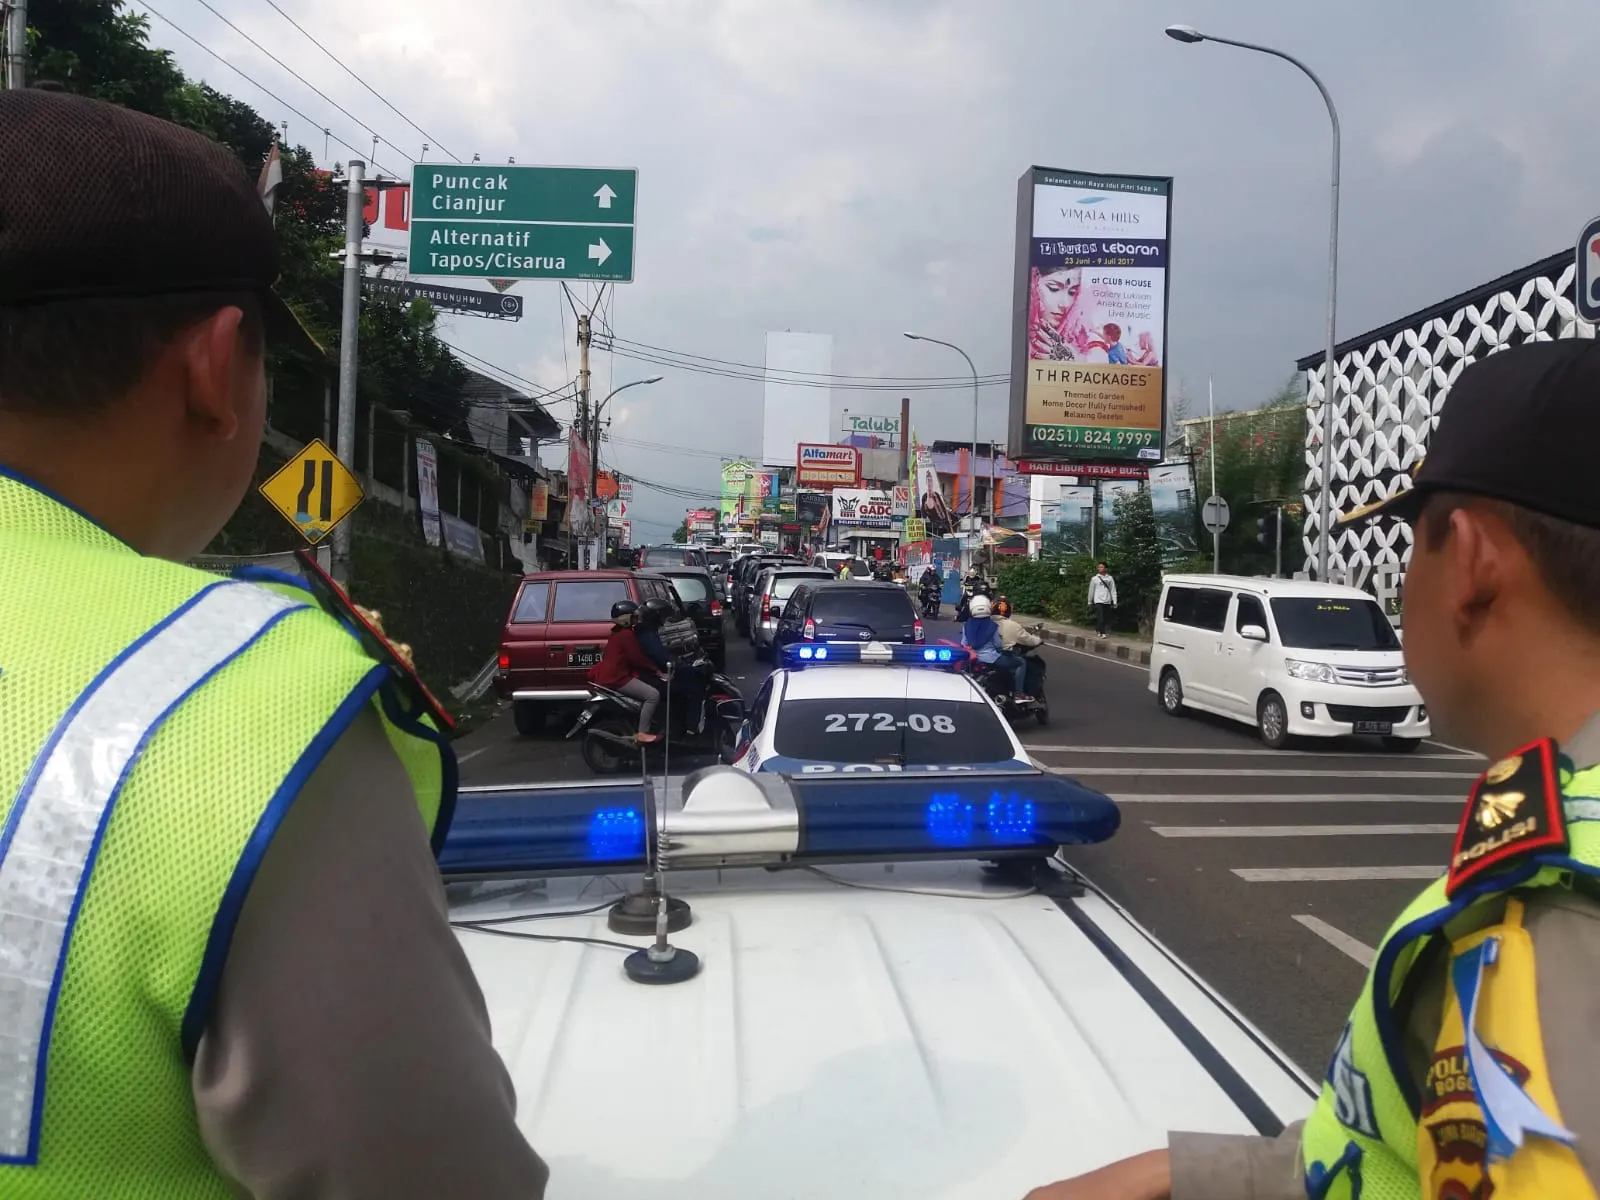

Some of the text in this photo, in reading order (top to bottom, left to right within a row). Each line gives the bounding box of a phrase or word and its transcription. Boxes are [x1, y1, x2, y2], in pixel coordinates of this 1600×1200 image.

[432, 173, 508, 190] Puncak
[1044, 176, 1071, 185] Selamat
[1073, 178, 1086, 186] Hari
[1088, 180, 1104, 189] Raya
[1106, 182, 1119, 190] Idul
[1120, 183, 1135, 191] Fitri
[432, 194, 505, 215] Cianjur
[1060, 207, 1140, 224] VIMALA HILLS
[429, 229, 531, 248] Alternatif
[1102, 242, 1159, 256] Lebaran
[429, 251, 566, 272] Tapos/Cisarua
[1064, 257, 1074, 265] 23
[1075, 257, 1090, 265] Juni
[1097, 257, 1102, 265] 9
[1103, 258, 1116, 266] Juli
[1117, 258, 1135, 266] 2017
[1091, 277, 1152, 288] at CLUB HOUSE
[415, 289, 482, 305] MEMBUNUHMU
[1092, 289, 1151, 301] Gallery Lukisan
[1096, 300, 1151, 310] Aneka Kuliner
[1108, 310, 1151, 320] Live Music
[1064, 390, 1125, 401] Thematic Garden
[1042, 399, 1064, 408] Home
[1065, 400, 1087, 409] Decor
[1088, 402, 1107, 412] (fully
[1064, 411, 1096, 420] Relaxing
[849, 416, 899, 432] Talubi
[1032, 427, 1152, 446] (0251) 824 9999
[803, 448, 853, 460] Alfamart
[1029, 463, 1053, 471] HARI
[1055, 464, 1085, 473] LIBUR
[1087, 465, 1117, 474] TETAP
[895, 501, 909, 510] BNI
[568, 654, 574, 663] B
[824, 712, 957, 734] 272-08
[1452, 815, 1538, 868] POLISI
